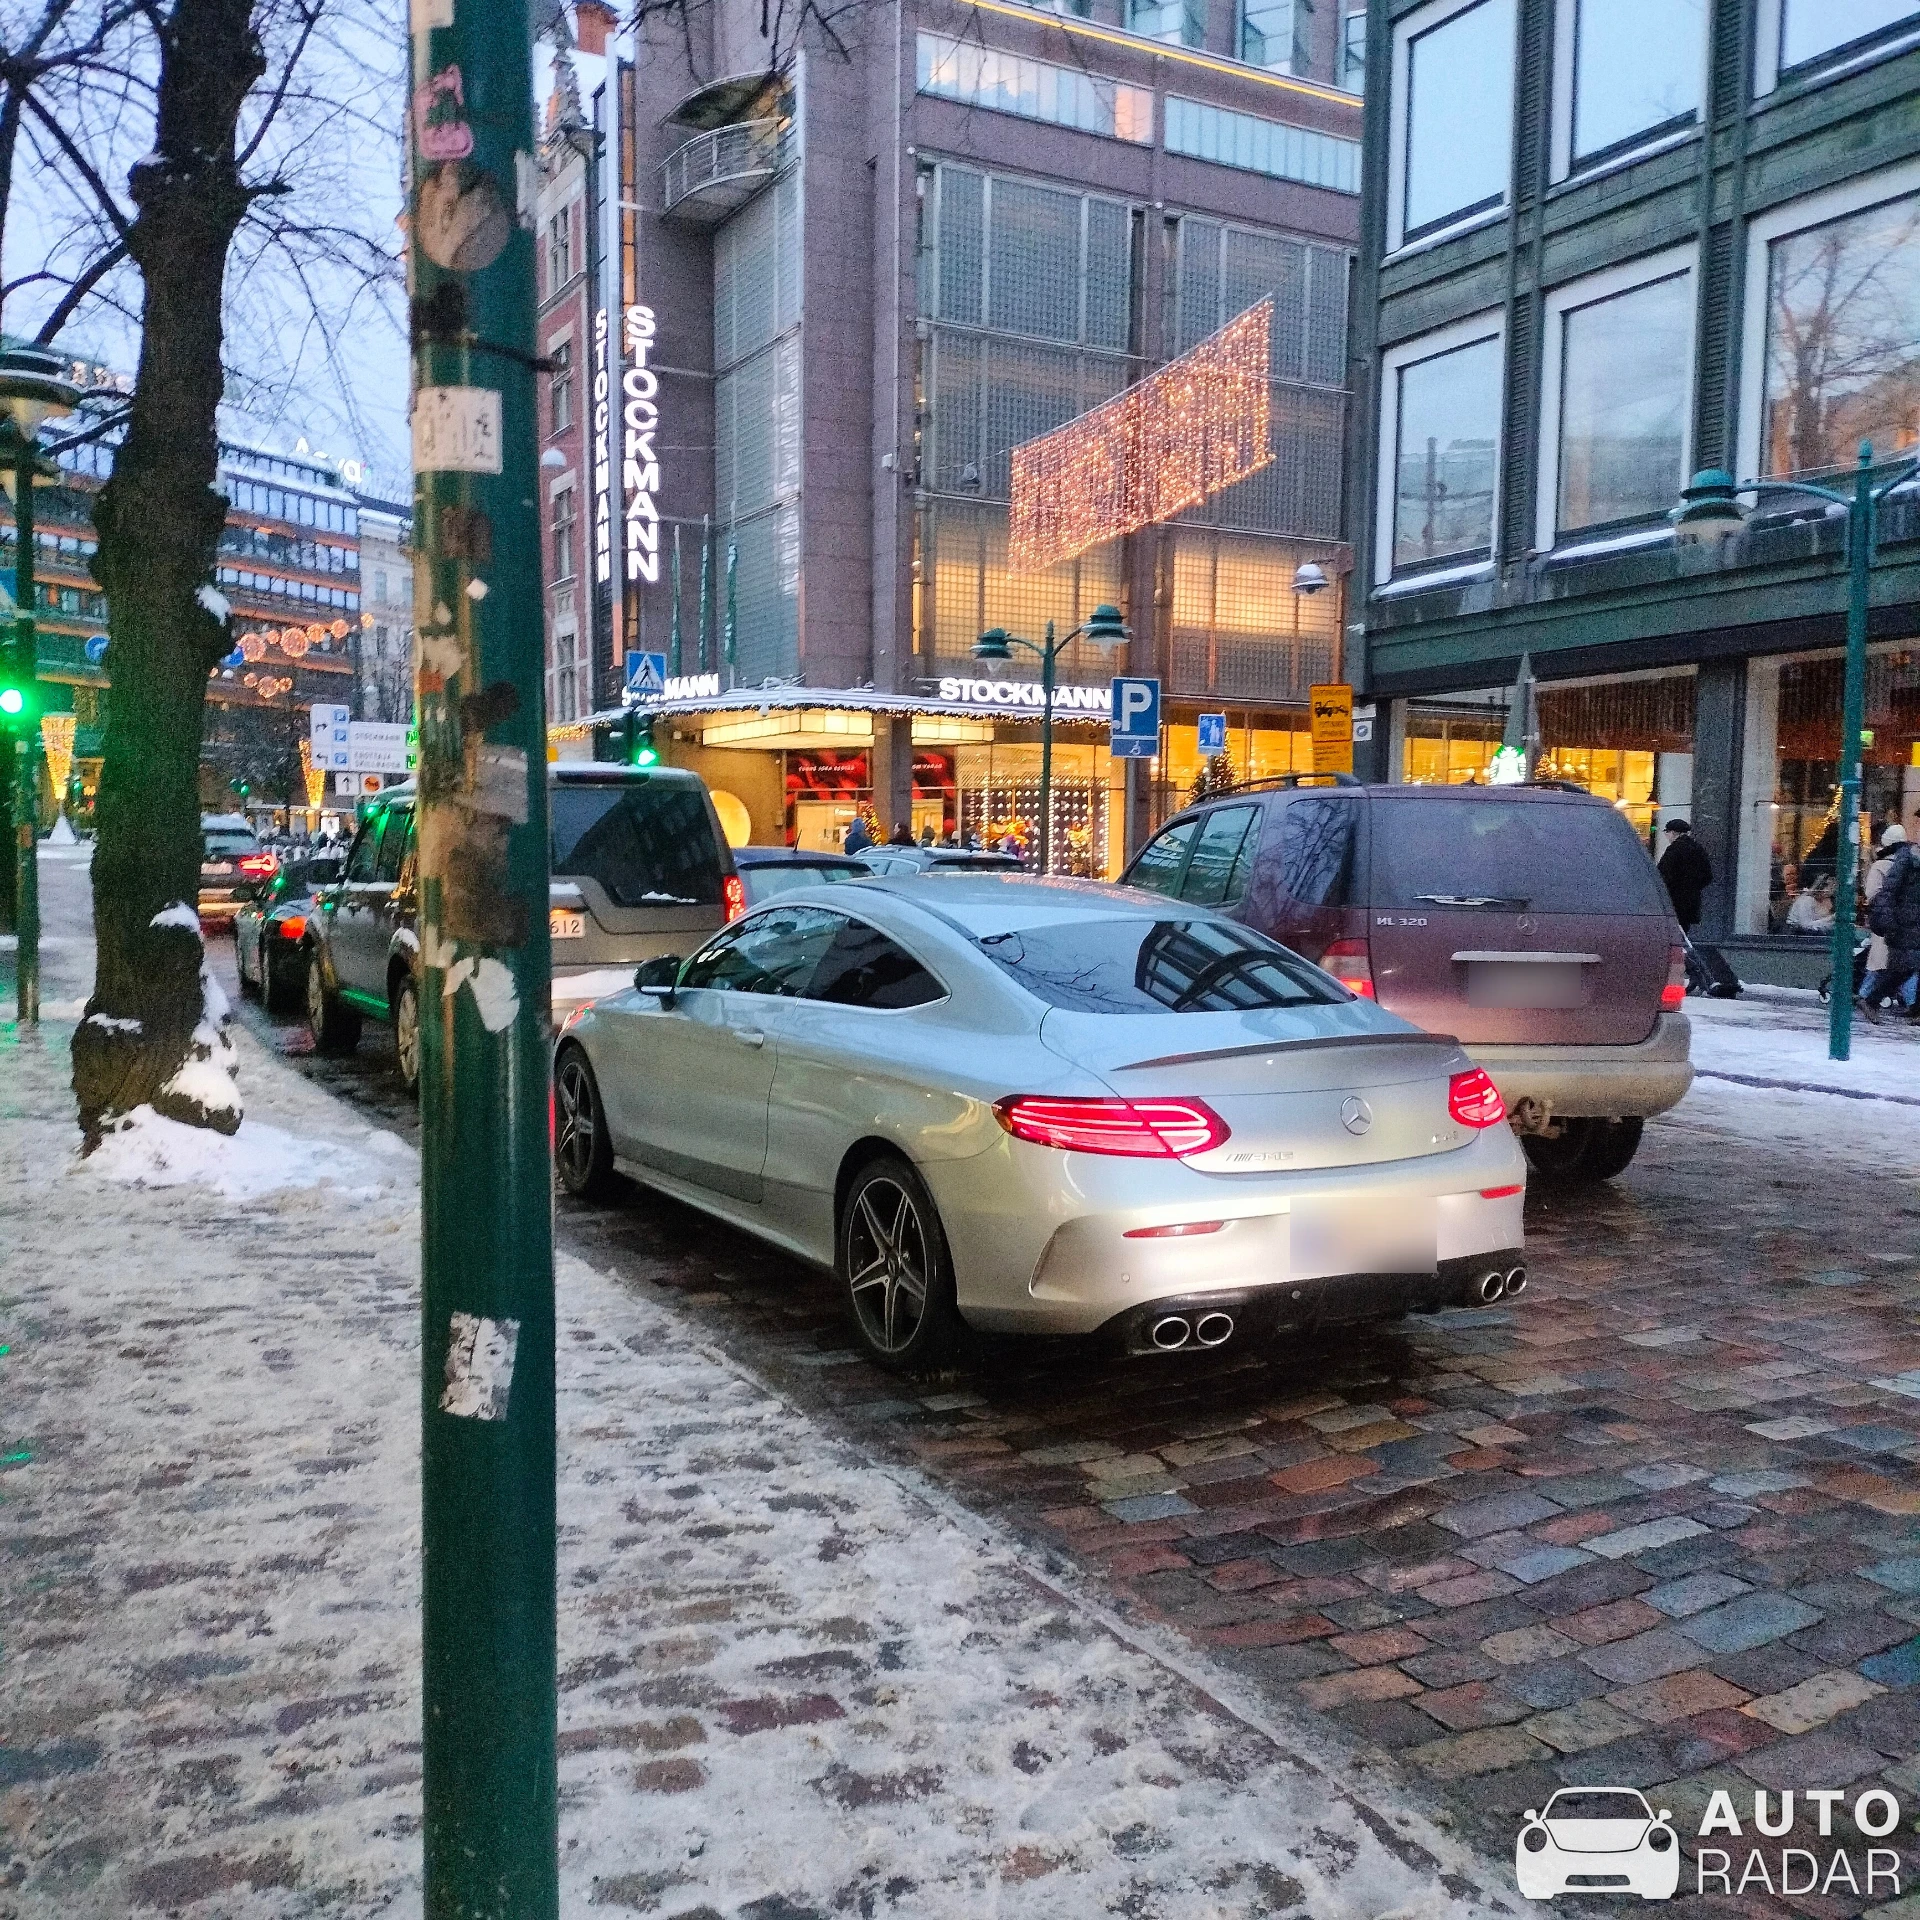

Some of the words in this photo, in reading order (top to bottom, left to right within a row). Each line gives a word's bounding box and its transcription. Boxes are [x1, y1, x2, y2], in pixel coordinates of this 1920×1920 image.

[595, 307, 610, 584] STOCKMANN
[622, 305, 660, 583] STOCKMANN
[621, 672, 719, 707] SMANN
[939, 677, 1112, 710] STOCKMANN
[1121, 683, 1153, 732] P
[550, 920, 580, 935] 612
[1399, 918, 1428, 927] 320
